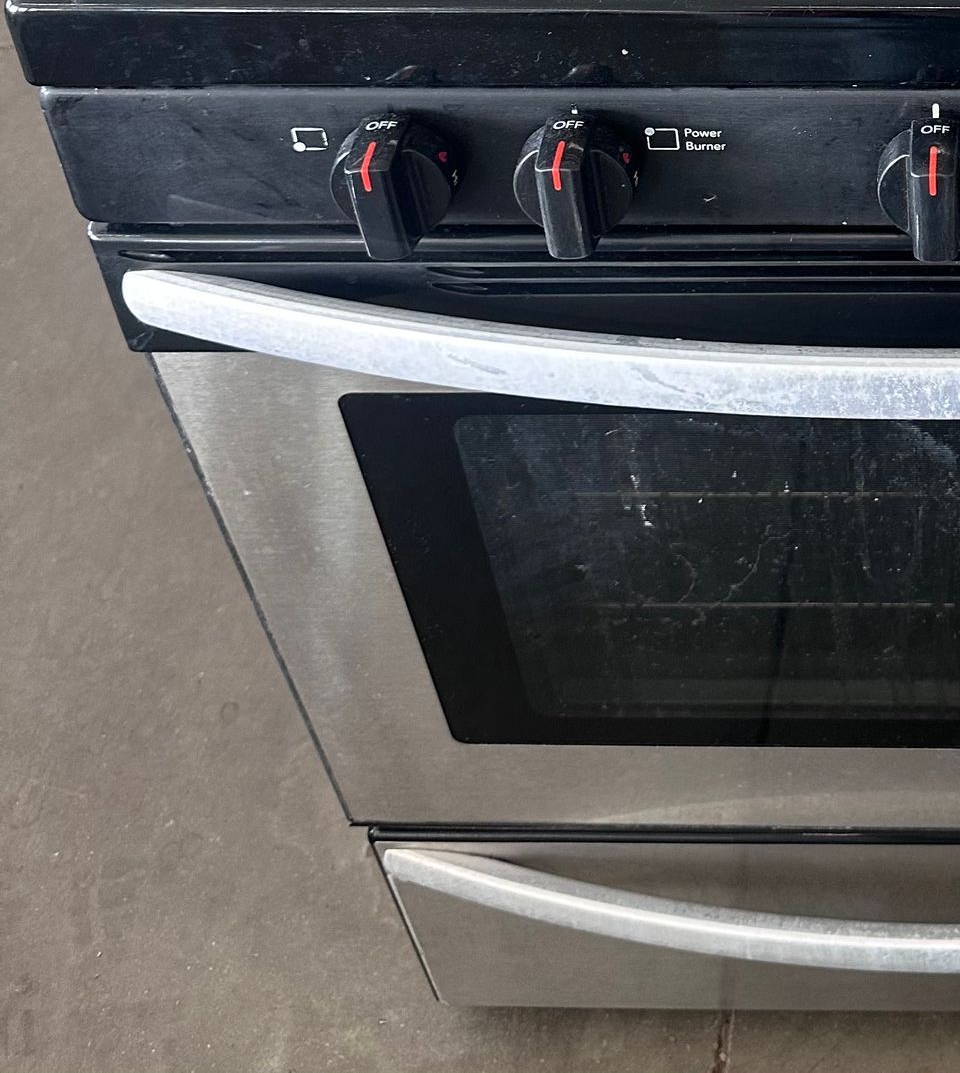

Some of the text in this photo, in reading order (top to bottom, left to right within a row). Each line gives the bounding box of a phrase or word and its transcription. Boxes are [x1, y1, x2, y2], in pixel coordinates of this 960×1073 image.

[365, 120, 399, 131] OFF
[552, 120, 585, 130] OFF
[920, 125, 951, 135] OFF
[684, 128, 722, 138] Power
[685, 141, 726, 151] Burner
